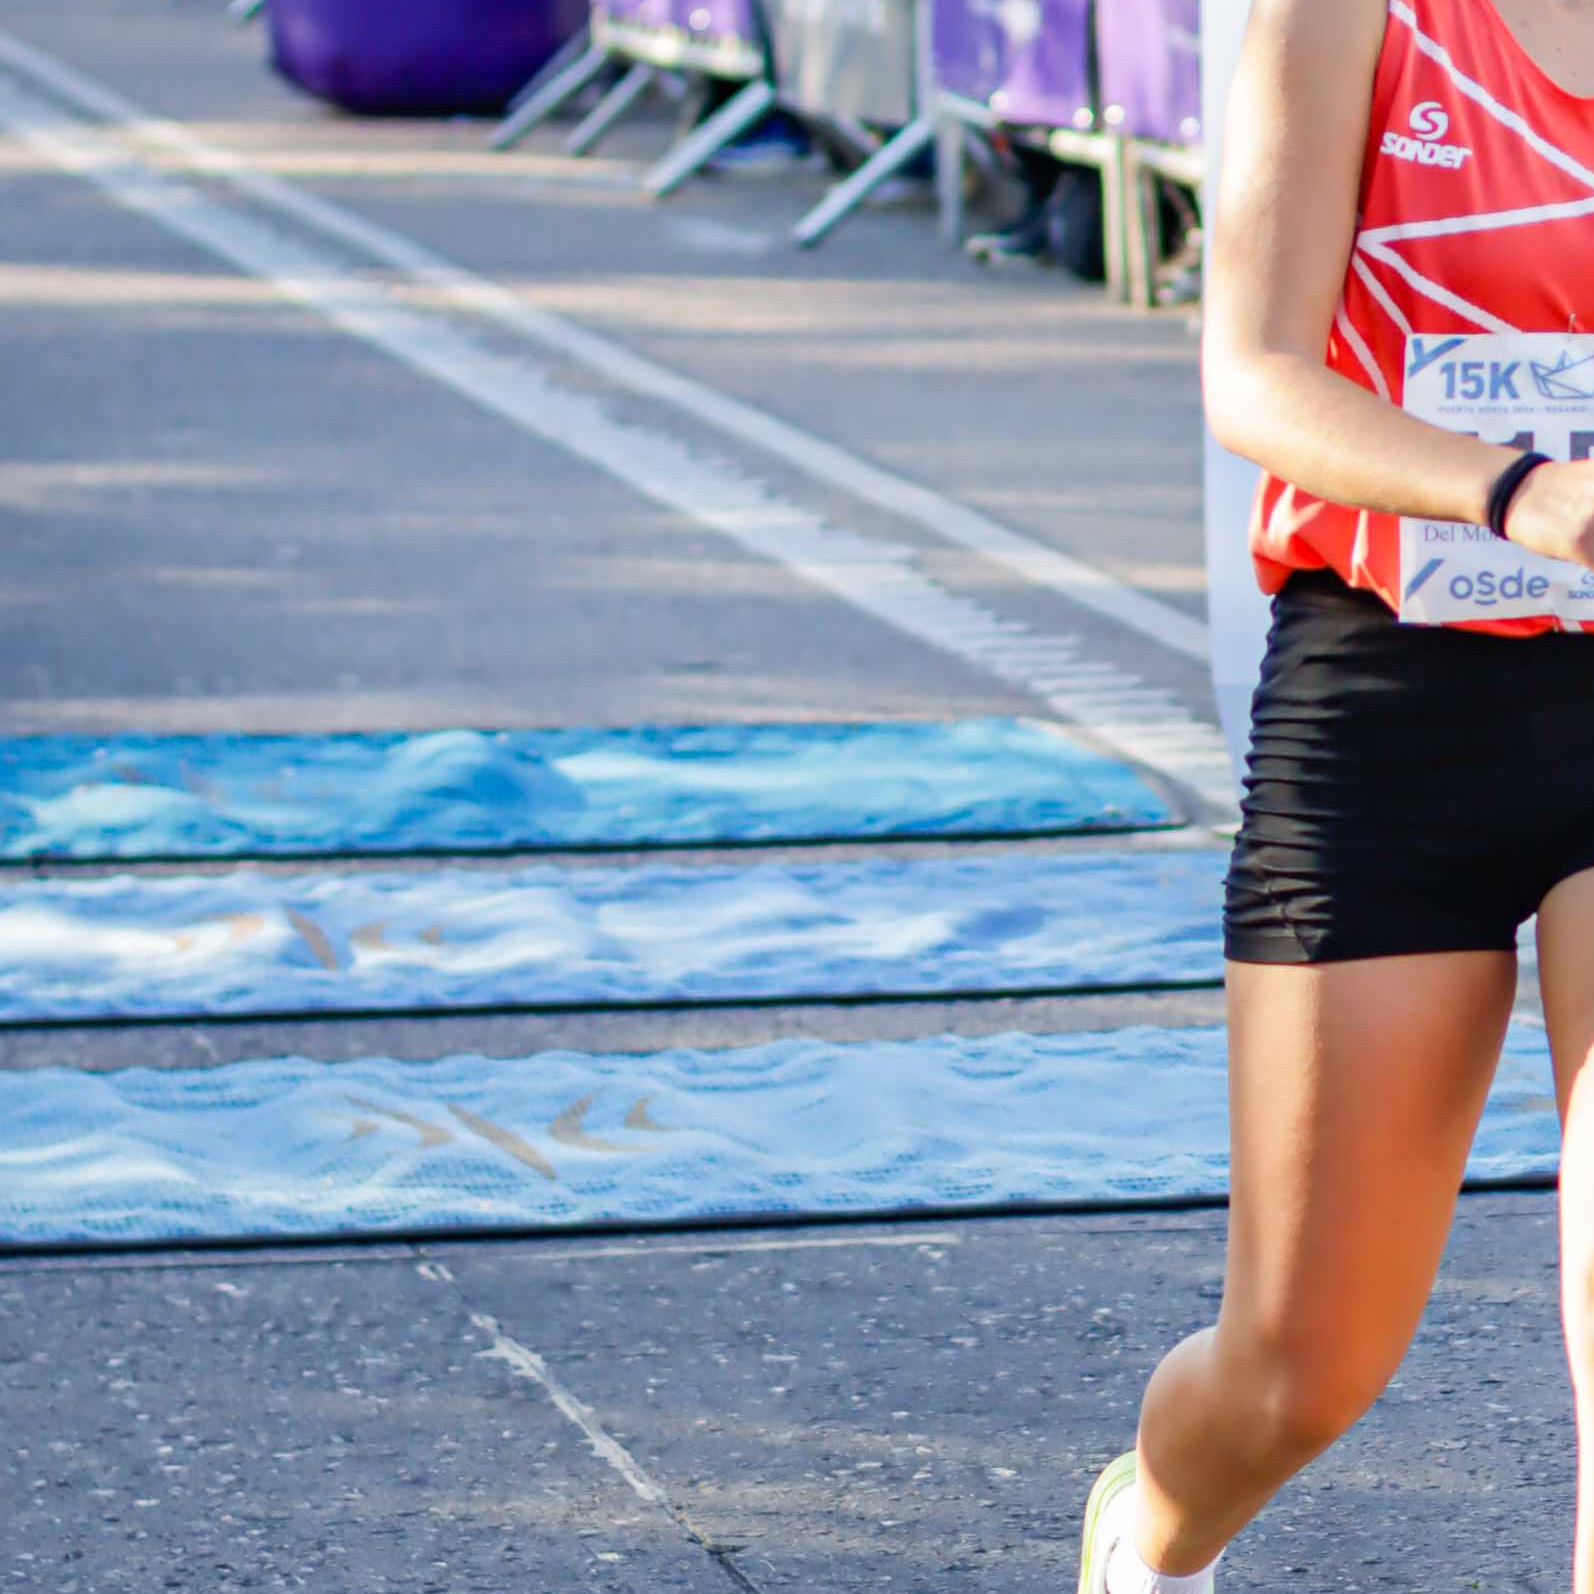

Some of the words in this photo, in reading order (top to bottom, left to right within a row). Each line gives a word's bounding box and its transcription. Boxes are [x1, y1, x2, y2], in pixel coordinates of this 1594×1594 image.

[1440, 361, 1521, 400] 15K
[1424, 524, 1455, 542] Del
[1450, 567, 1549, 605] osde
